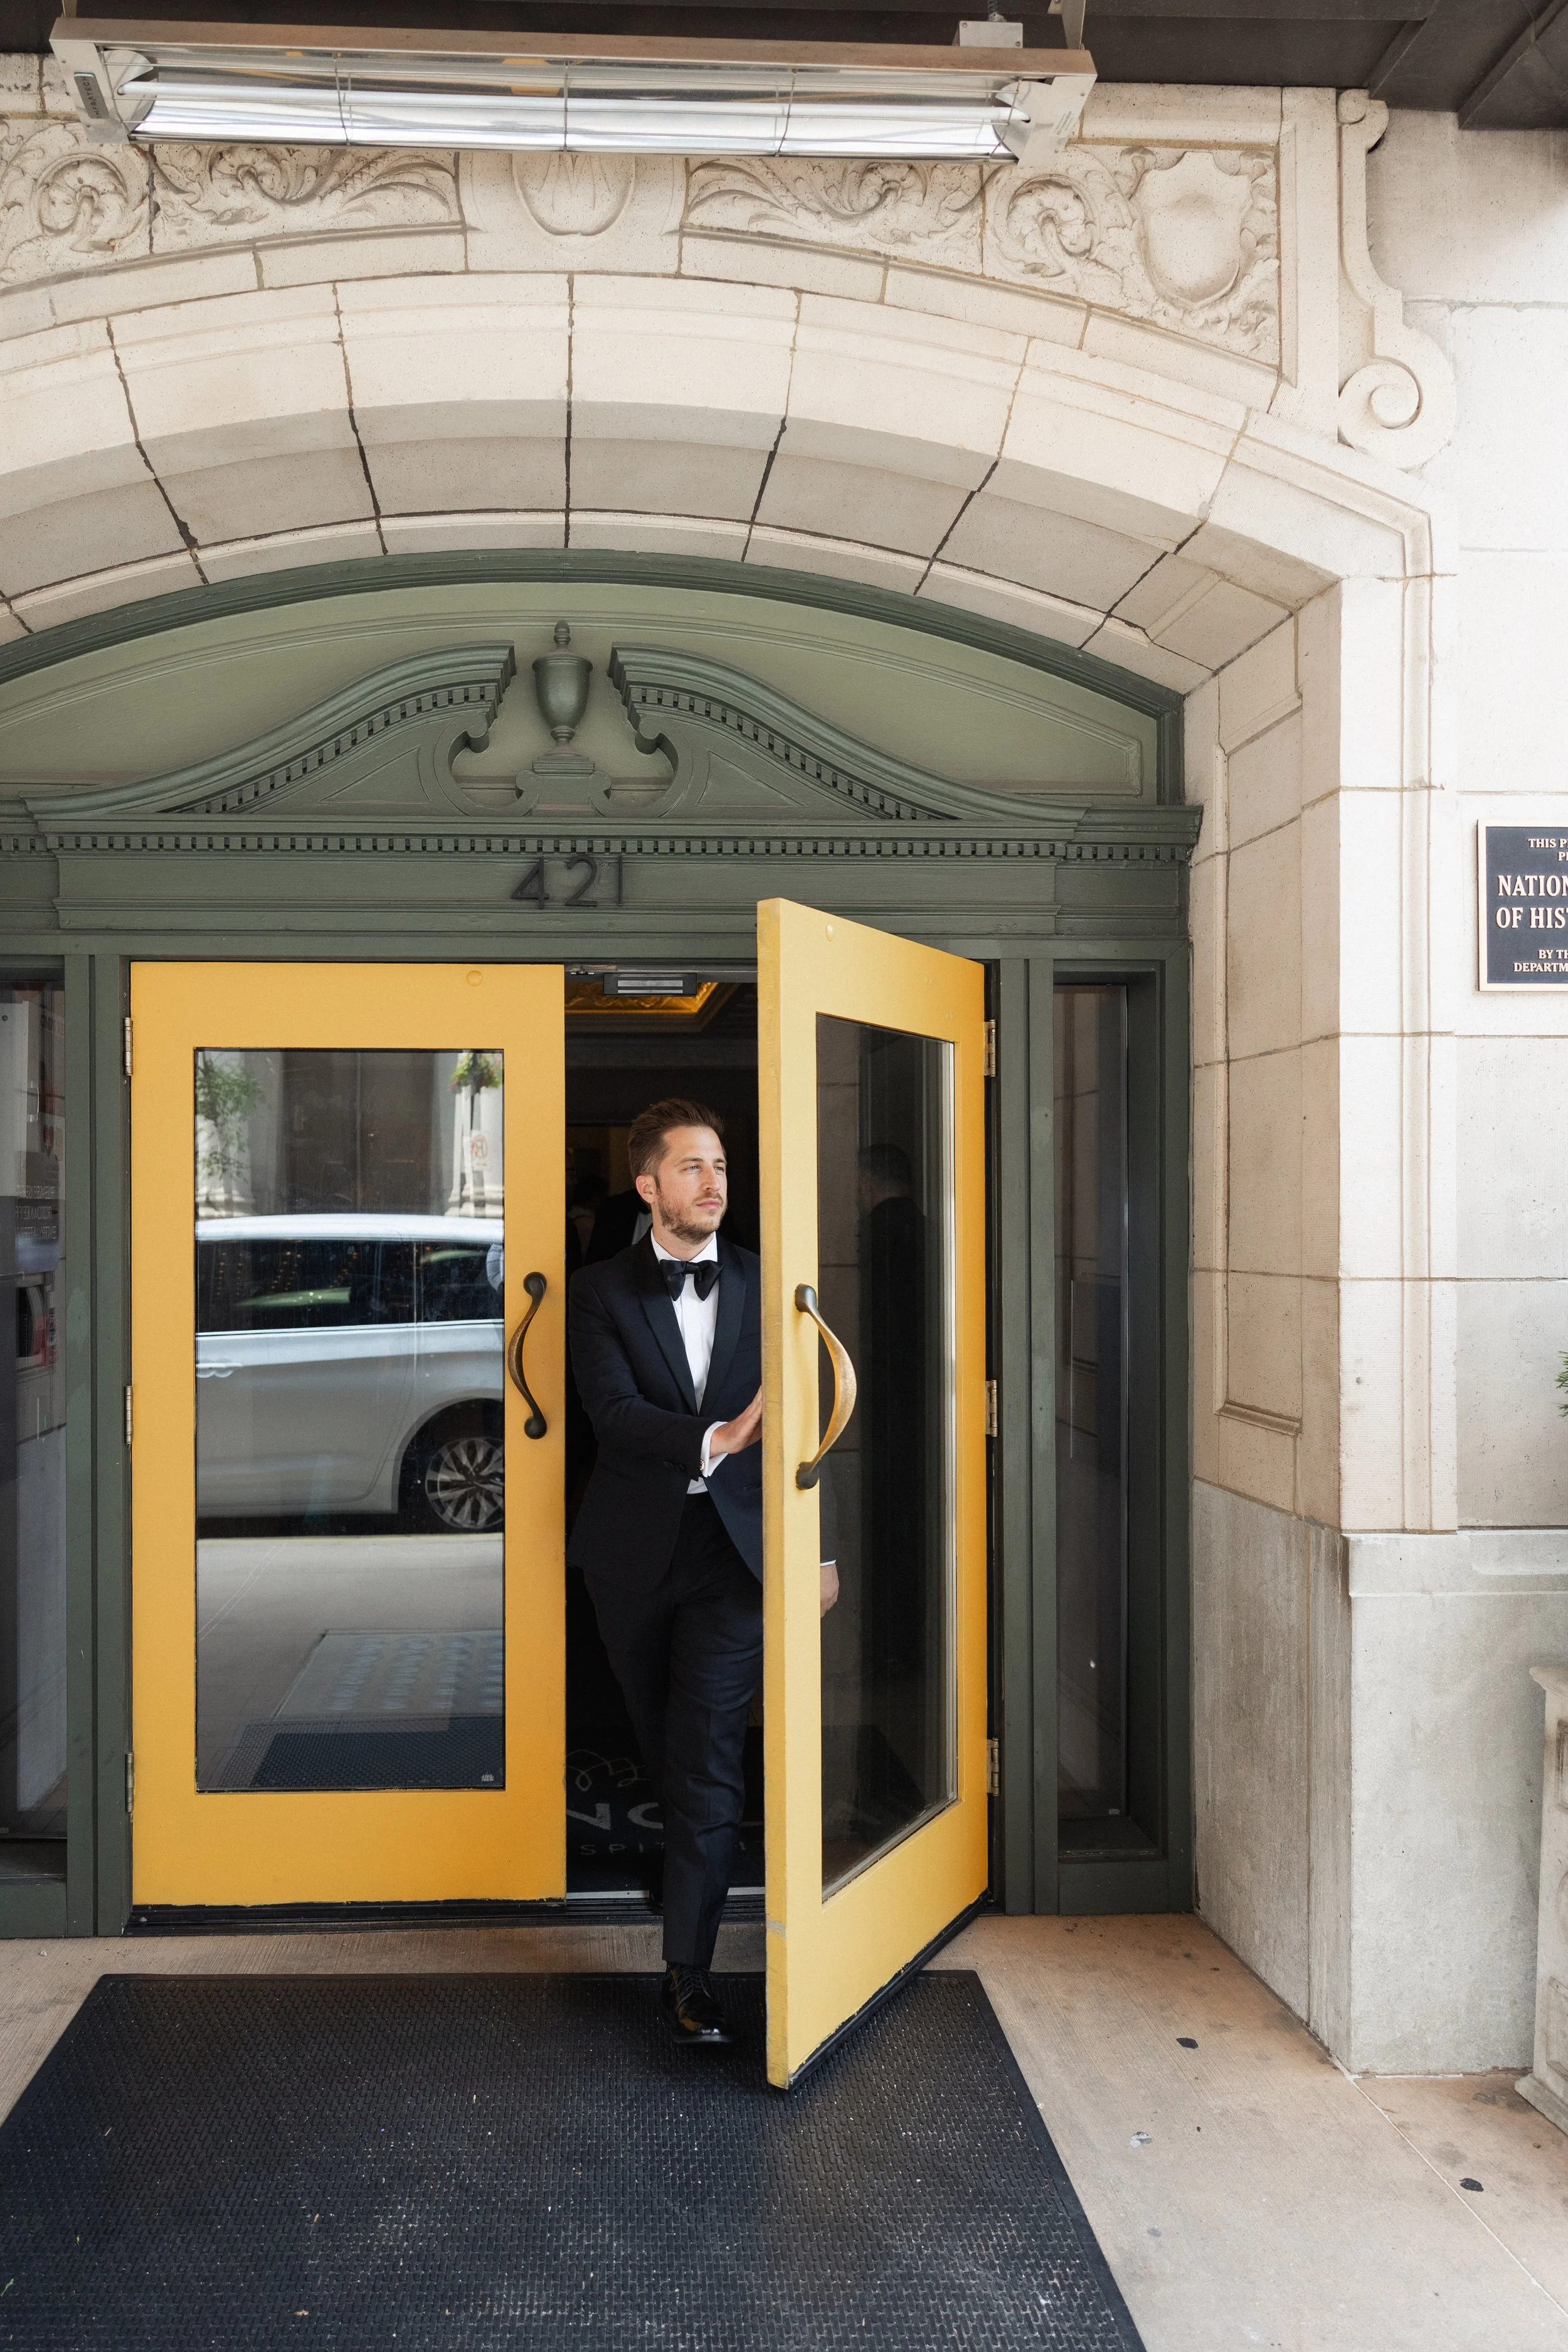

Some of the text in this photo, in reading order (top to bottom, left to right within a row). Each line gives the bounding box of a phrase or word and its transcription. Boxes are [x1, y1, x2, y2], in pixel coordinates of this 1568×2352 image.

[82, 76, 102, 119] INFRATECH
[1528, 838, 1557, 848] THIS
[511, 854, 623, 909] 421
[1496, 907, 1568, 929] OF HIS
[1539, 949, 1554, 959] BY
[1513, 962, 1568, 972] DEPARTM
